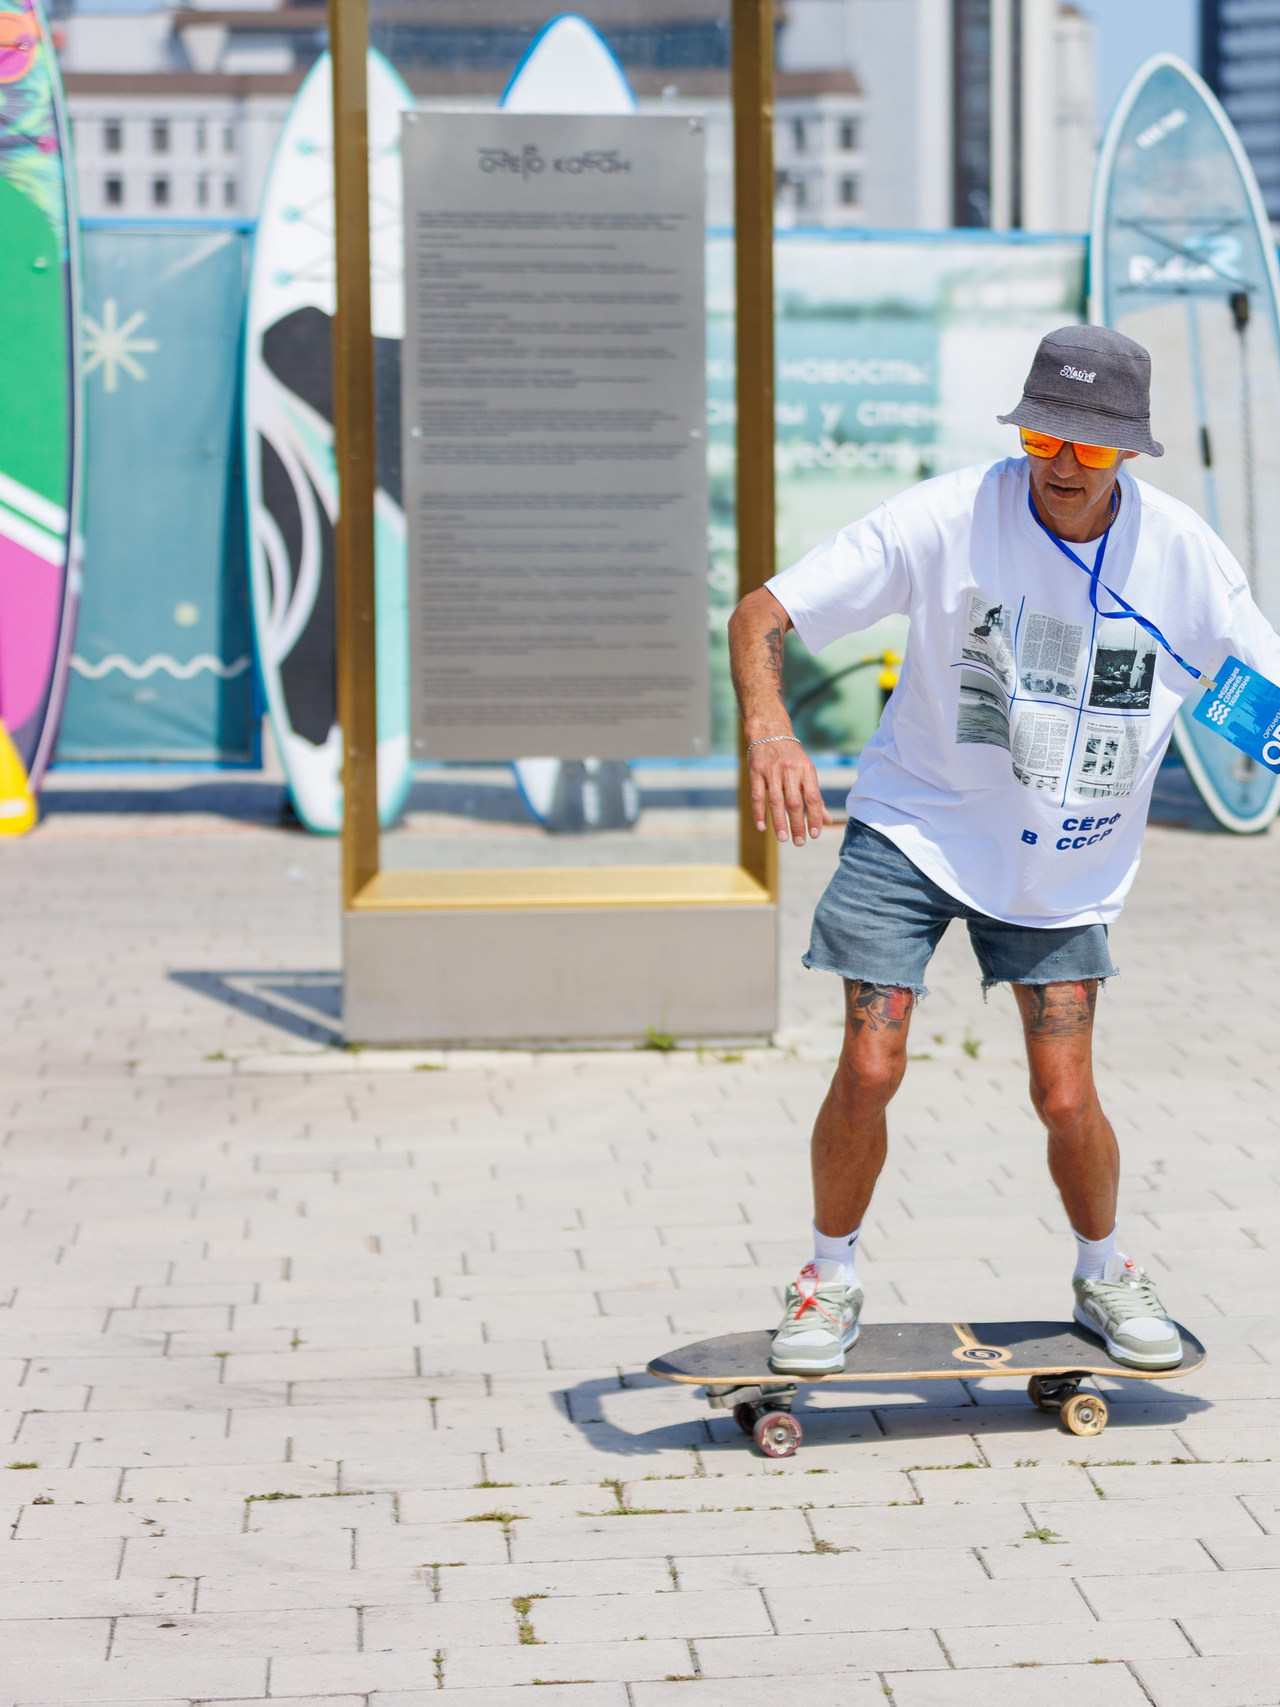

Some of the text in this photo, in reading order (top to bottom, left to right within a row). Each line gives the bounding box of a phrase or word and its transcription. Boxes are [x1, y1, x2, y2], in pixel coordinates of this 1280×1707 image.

[1218, 667, 1240, 699] ФЕДЕРАЦИЯ
[1021, 828, 1113, 850] В СССР
